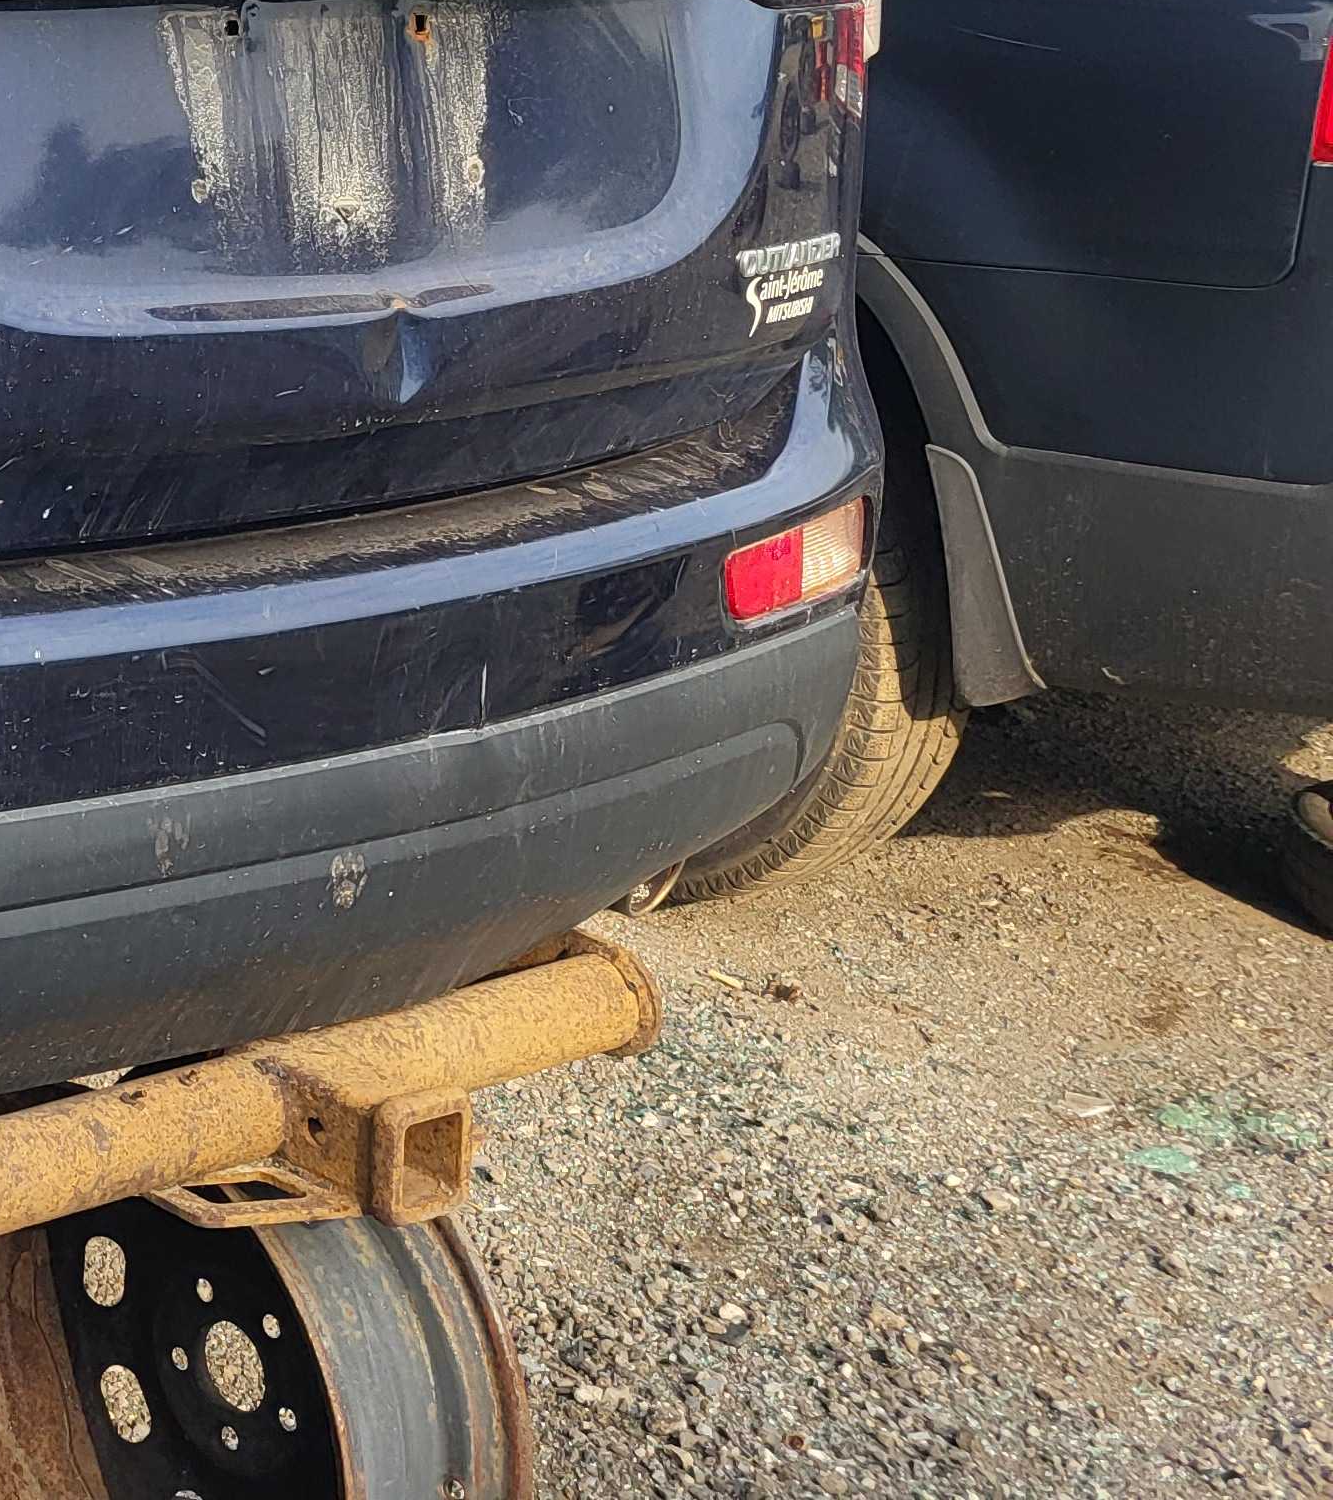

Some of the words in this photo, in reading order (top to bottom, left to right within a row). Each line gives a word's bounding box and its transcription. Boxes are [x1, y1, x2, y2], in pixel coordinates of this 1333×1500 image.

[736, 232, 841, 278] OUTLANDER
[746, 266, 824, 338] Saint-Jérôme
[766, 295, 814, 324] MITSUBISHI
